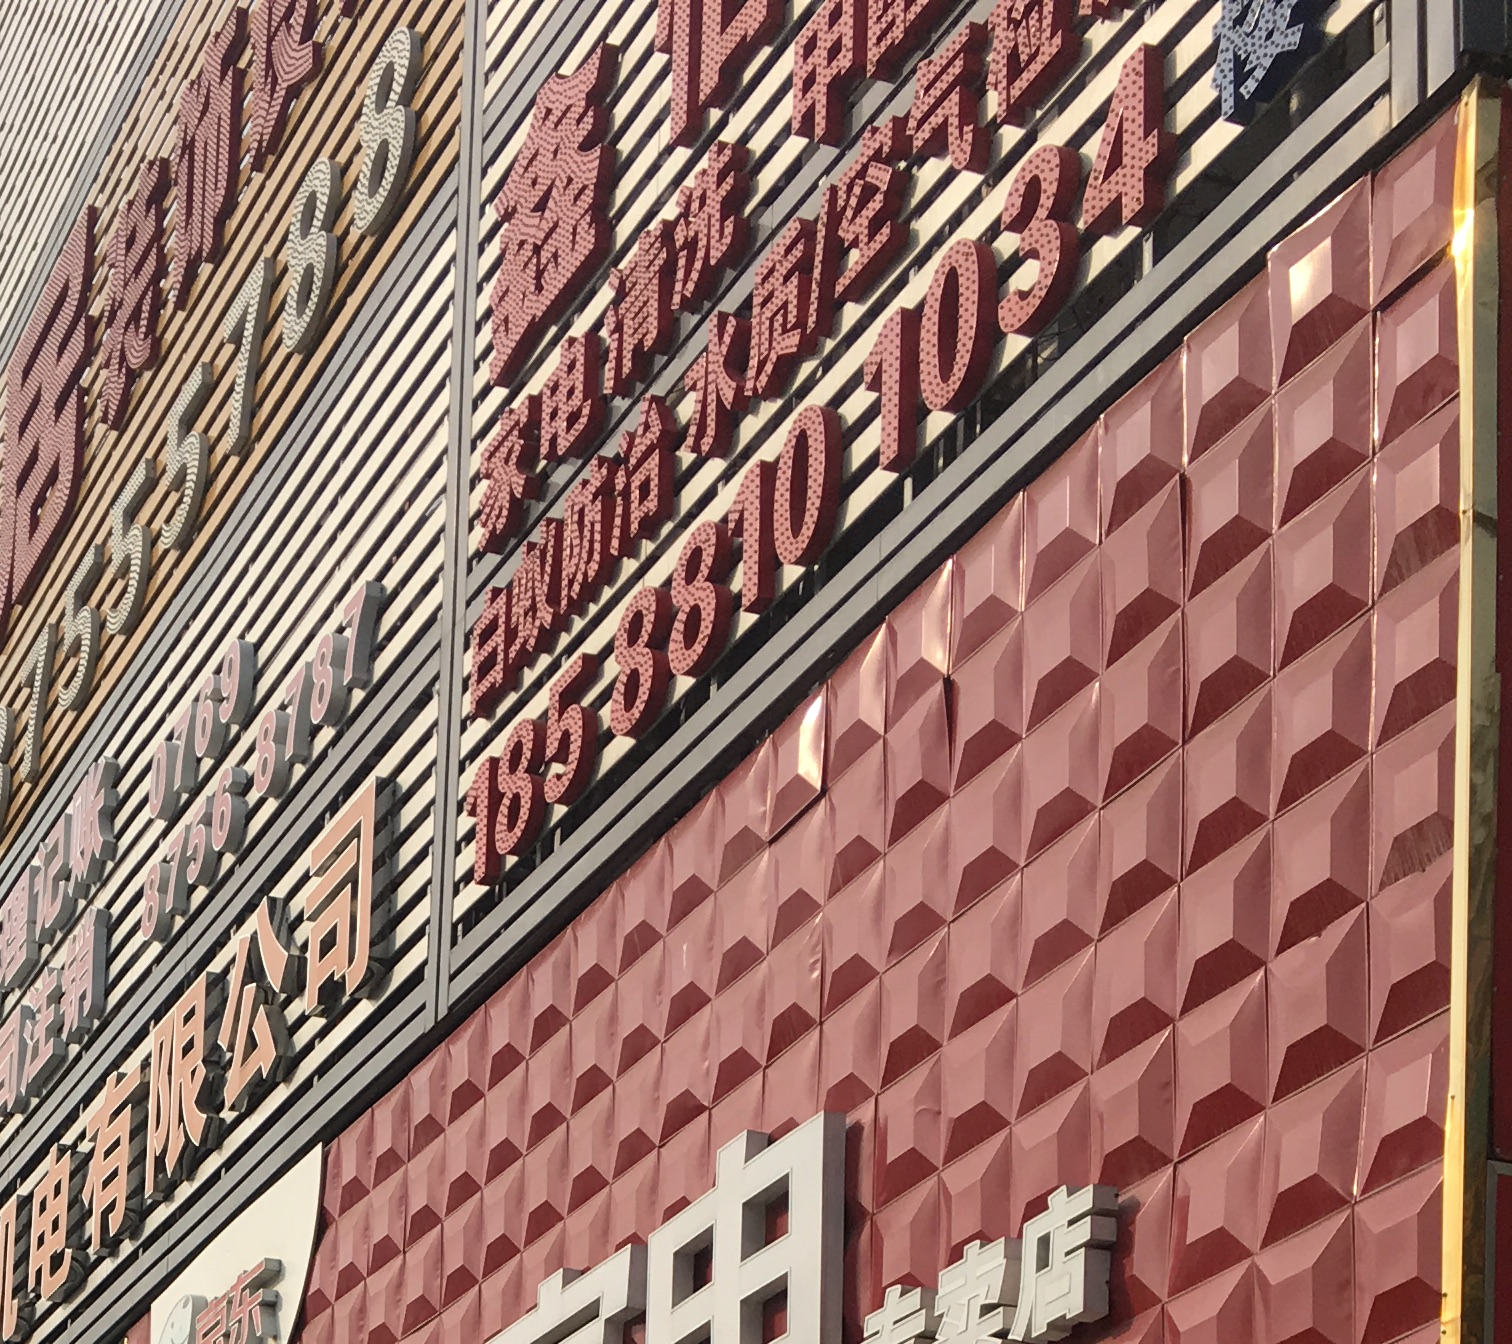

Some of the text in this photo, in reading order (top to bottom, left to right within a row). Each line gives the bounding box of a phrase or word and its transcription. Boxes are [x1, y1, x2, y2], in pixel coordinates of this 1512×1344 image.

[479, 145, 750, 551] 家电清洗
[469, 395, 676, 716] 白蚁防治
[149, 638, 254, 819] 0769
